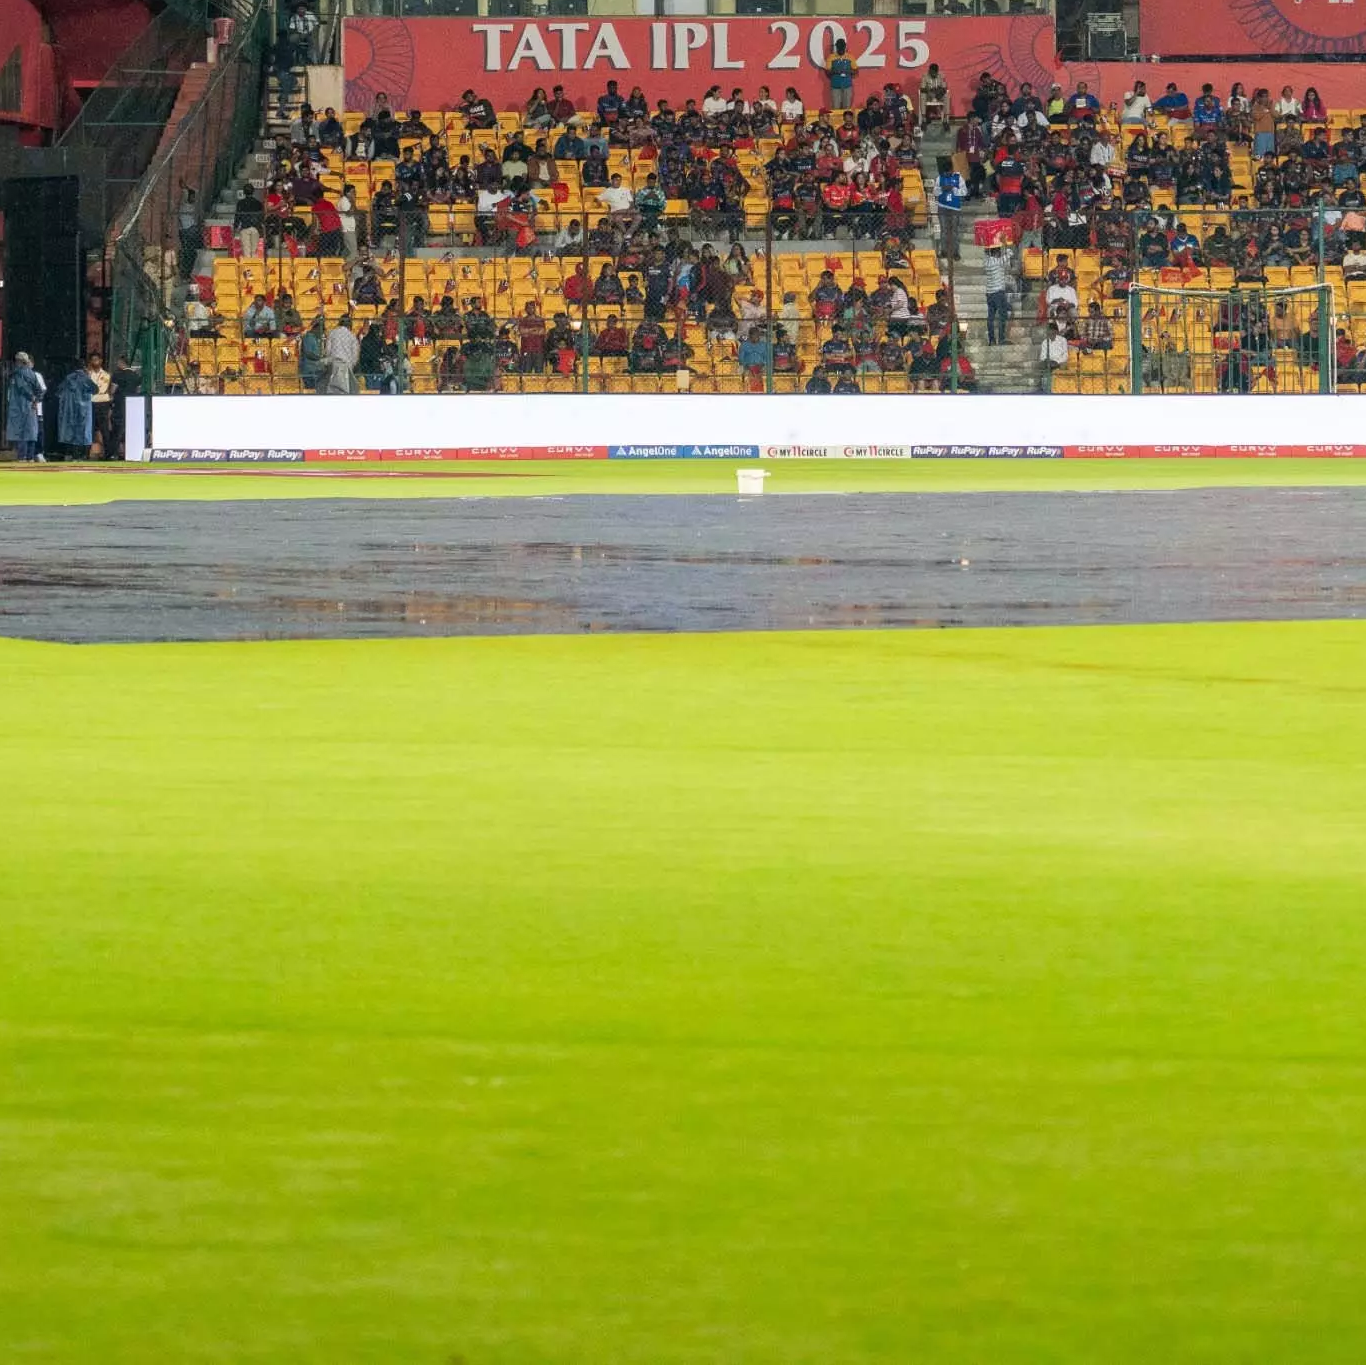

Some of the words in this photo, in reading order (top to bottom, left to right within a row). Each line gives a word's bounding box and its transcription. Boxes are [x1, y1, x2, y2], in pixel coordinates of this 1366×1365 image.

[473, 23, 632, 70] TATA
[651, 22, 745, 69] IPL
[767, 20, 931, 69] 2025
[153, 449, 185, 459] RuPay
[191, 449, 222, 459] RuPay
[229, 449, 261, 459] RuPay
[267, 449, 299, 459] RuPay
[629, 446, 677, 456] AngelOne
[703, 445, 752, 456] AngelOne
[913, 446, 945, 456] RuPay
[951, 446, 982, 456] RuPay
[989, 446, 1020, 456] RuPay
[1026, 446, 1058, 456] RuPay
